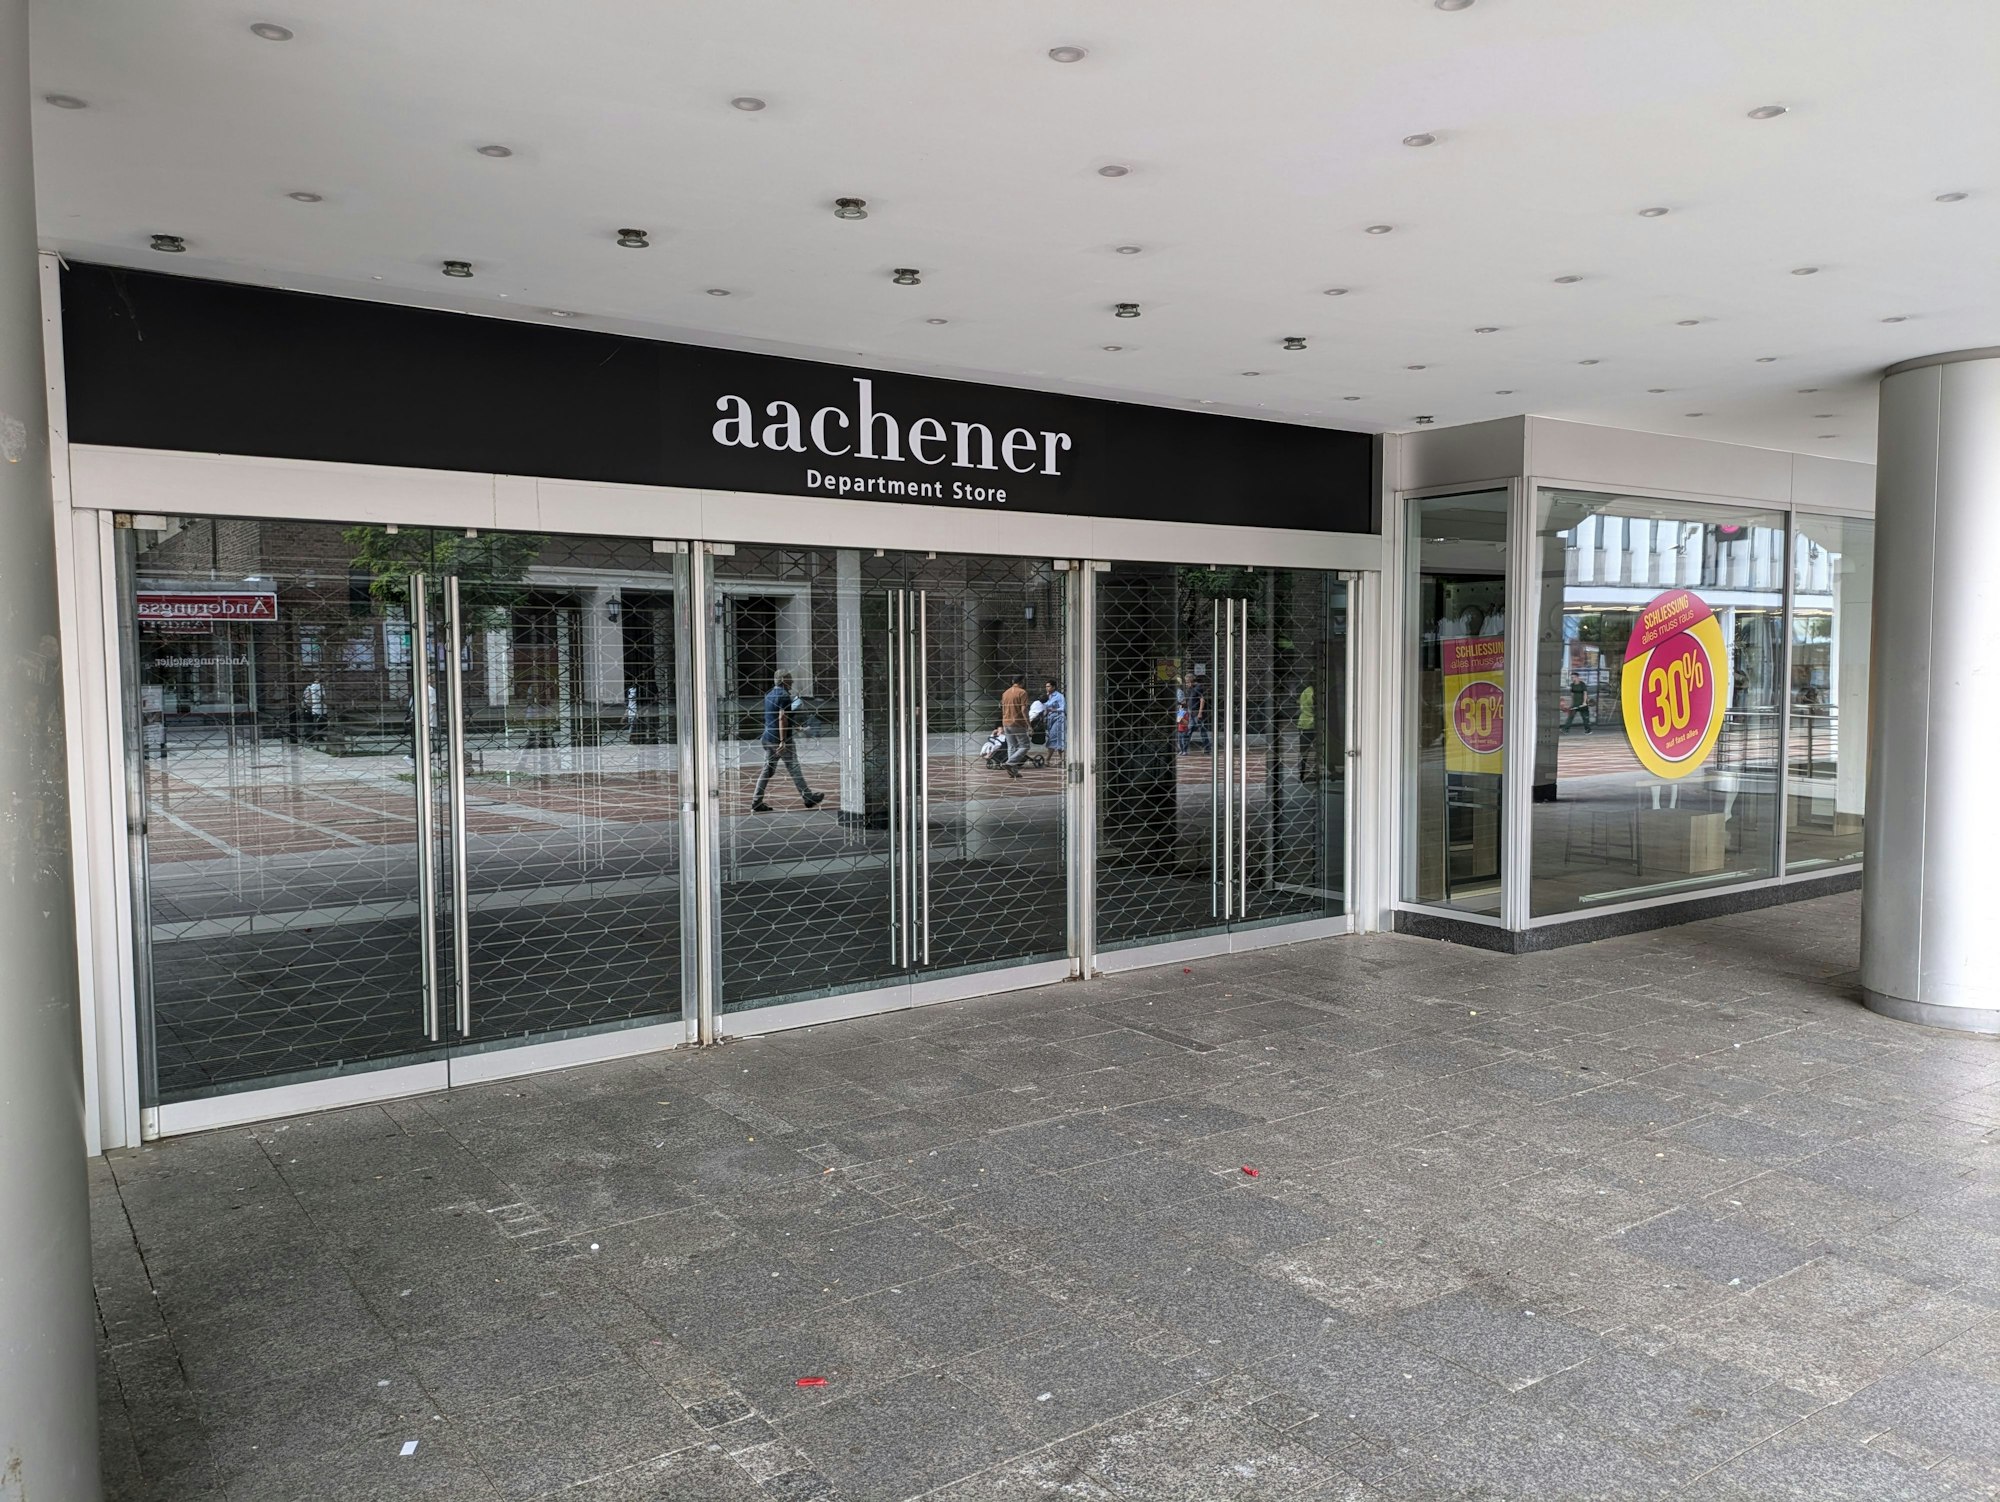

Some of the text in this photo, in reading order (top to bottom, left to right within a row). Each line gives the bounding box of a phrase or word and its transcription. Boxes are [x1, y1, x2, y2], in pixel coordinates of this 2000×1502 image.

[712, 377, 1072, 476] aachener
[807, 469, 1007, 503] Department Store
[1642, 609, 1694, 645] alles muss raus
[1644, 594, 1689, 630] SCHLIESSUNG
[1451, 659, 1469, 669] alles
[1471, 656, 1494, 667] muss
[1648, 649, 1704, 738] 30%
[1460, 696, 1504, 737] 30%
[1665, 729, 1699, 749] auf fast alles
